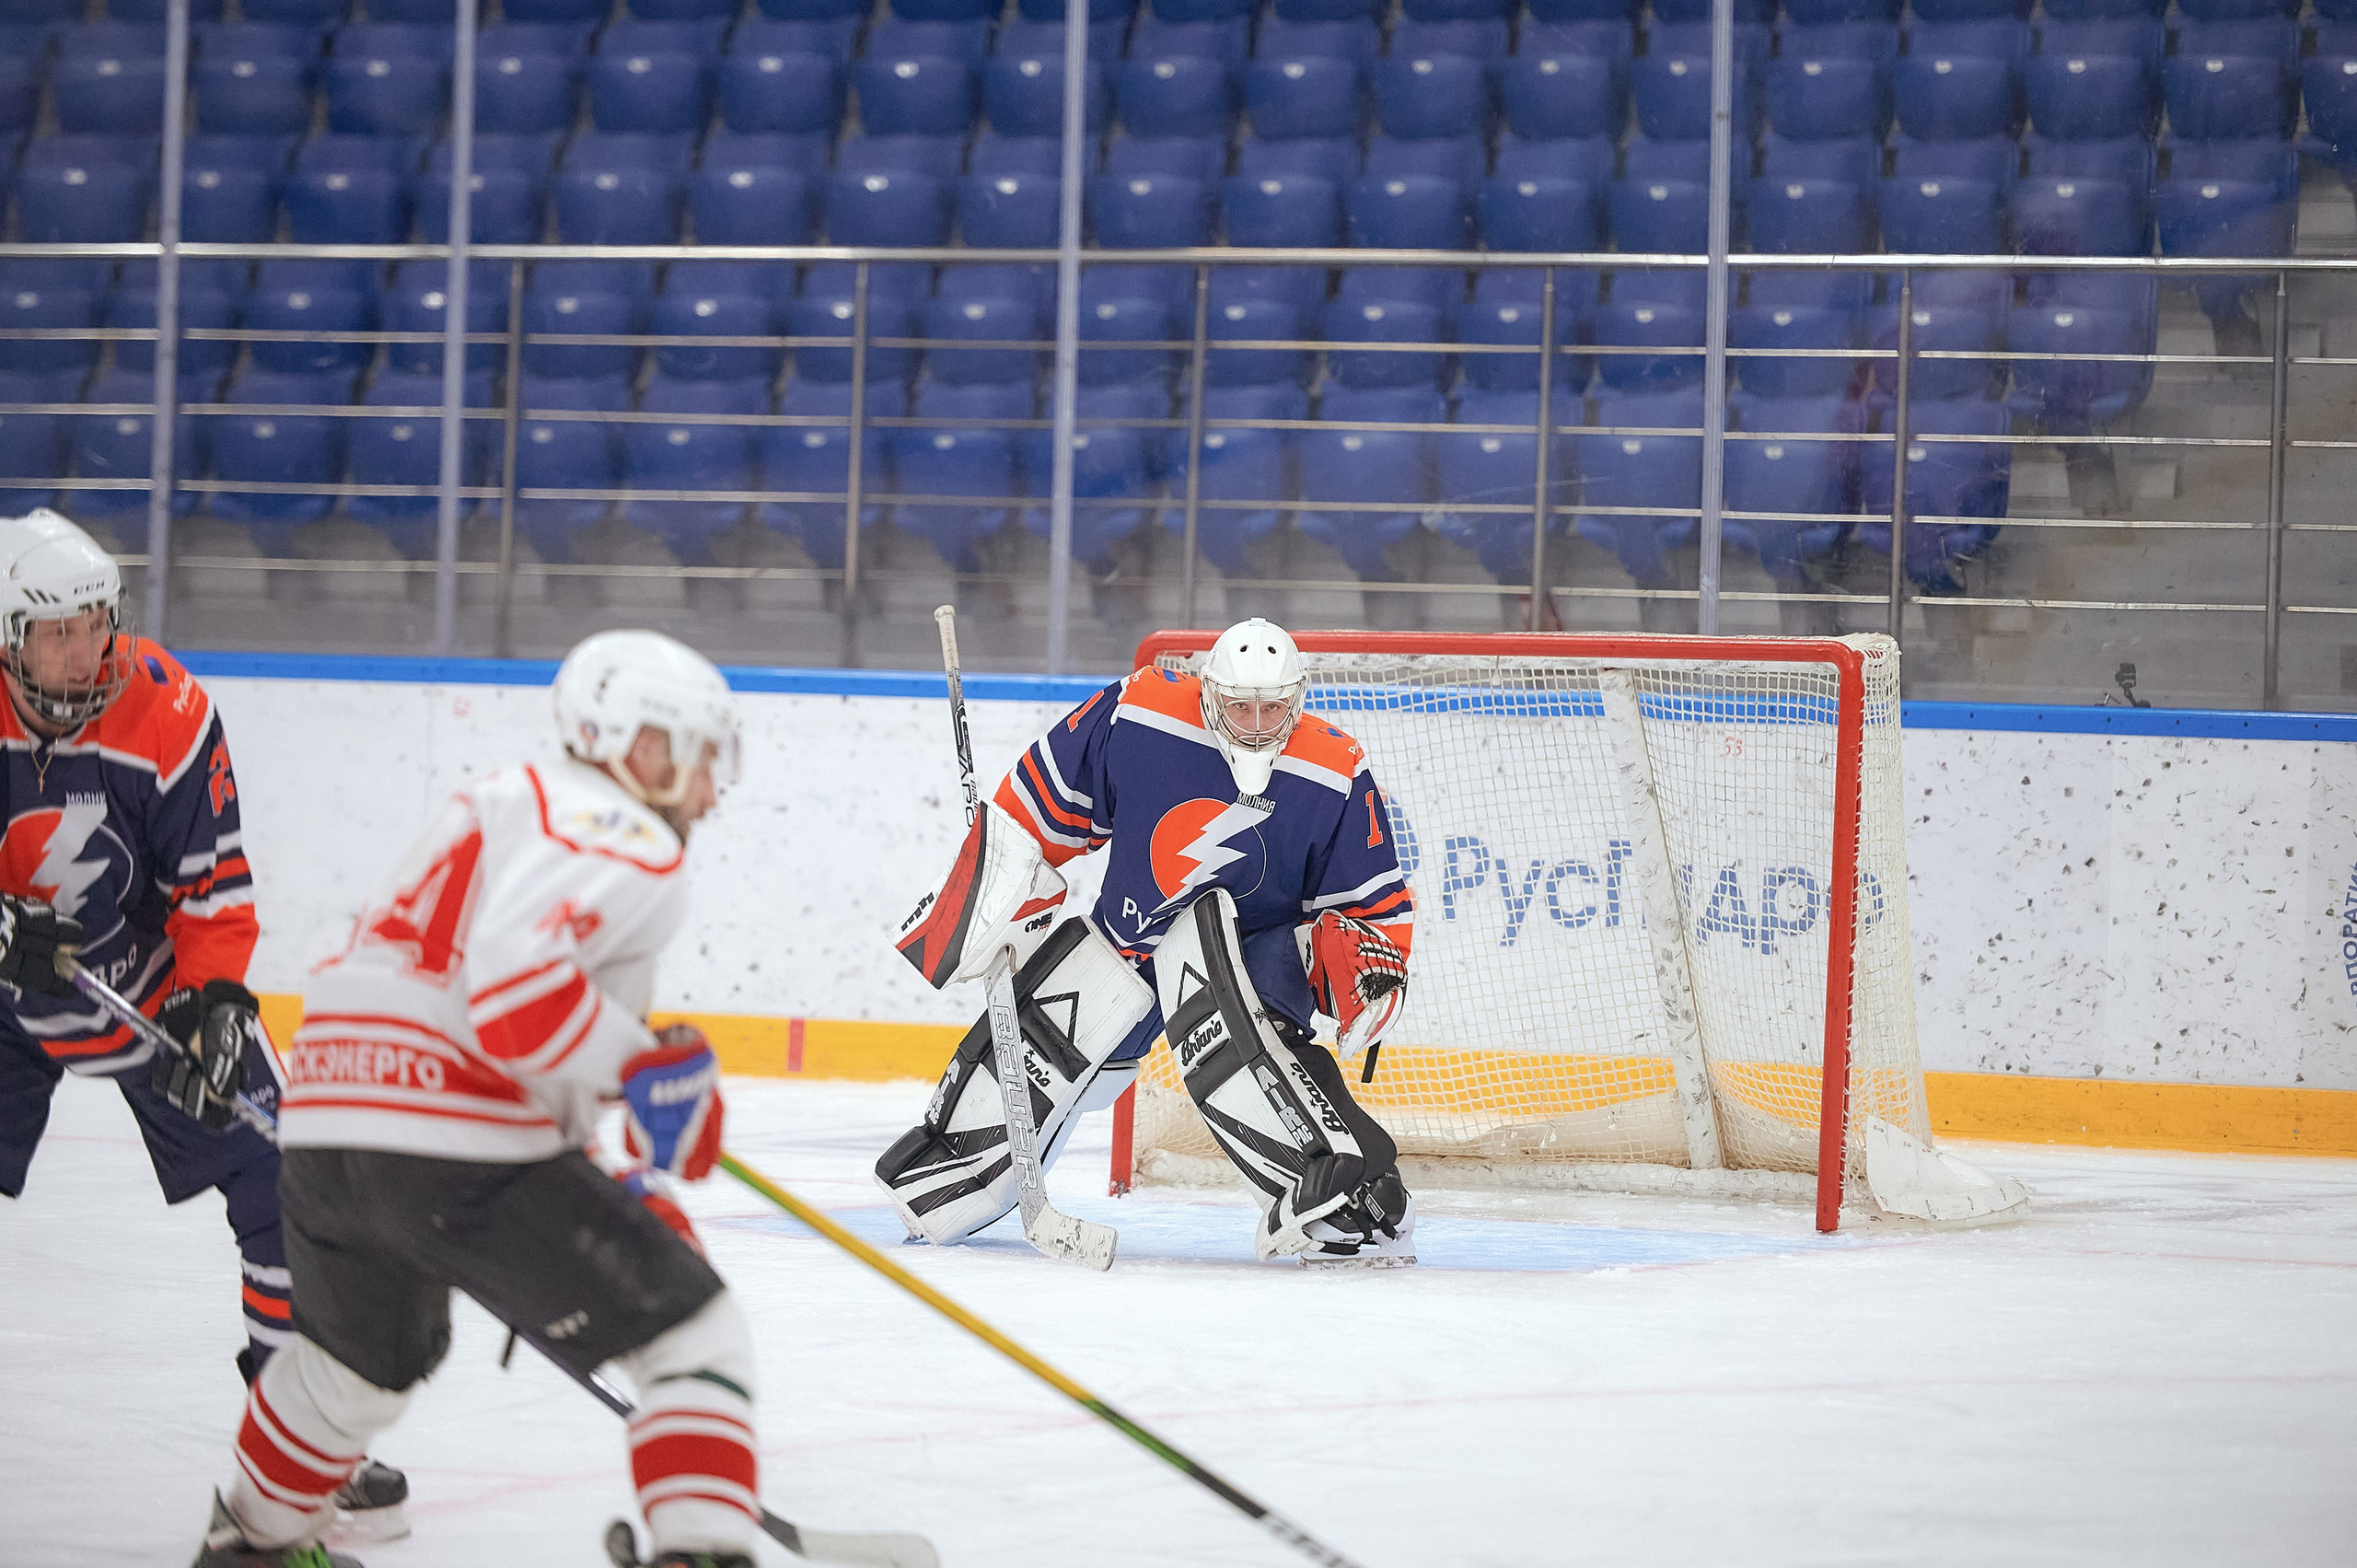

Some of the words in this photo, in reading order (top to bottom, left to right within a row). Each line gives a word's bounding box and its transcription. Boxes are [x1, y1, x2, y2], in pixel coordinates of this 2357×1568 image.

[1067, 688, 1105, 734] 1
[1237, 792, 1277, 814] МОЛНИЯ
[1364, 789, 1384, 850] 1
[1181, 1019, 1223, 1067] Brian's
[993, 1005, 1039, 1191] BAUER
[1254, 1064, 1305, 1132] AIR
[1291, 1124, 1314, 1147] PAC
[1290, 1062, 1350, 1136] Brian's
